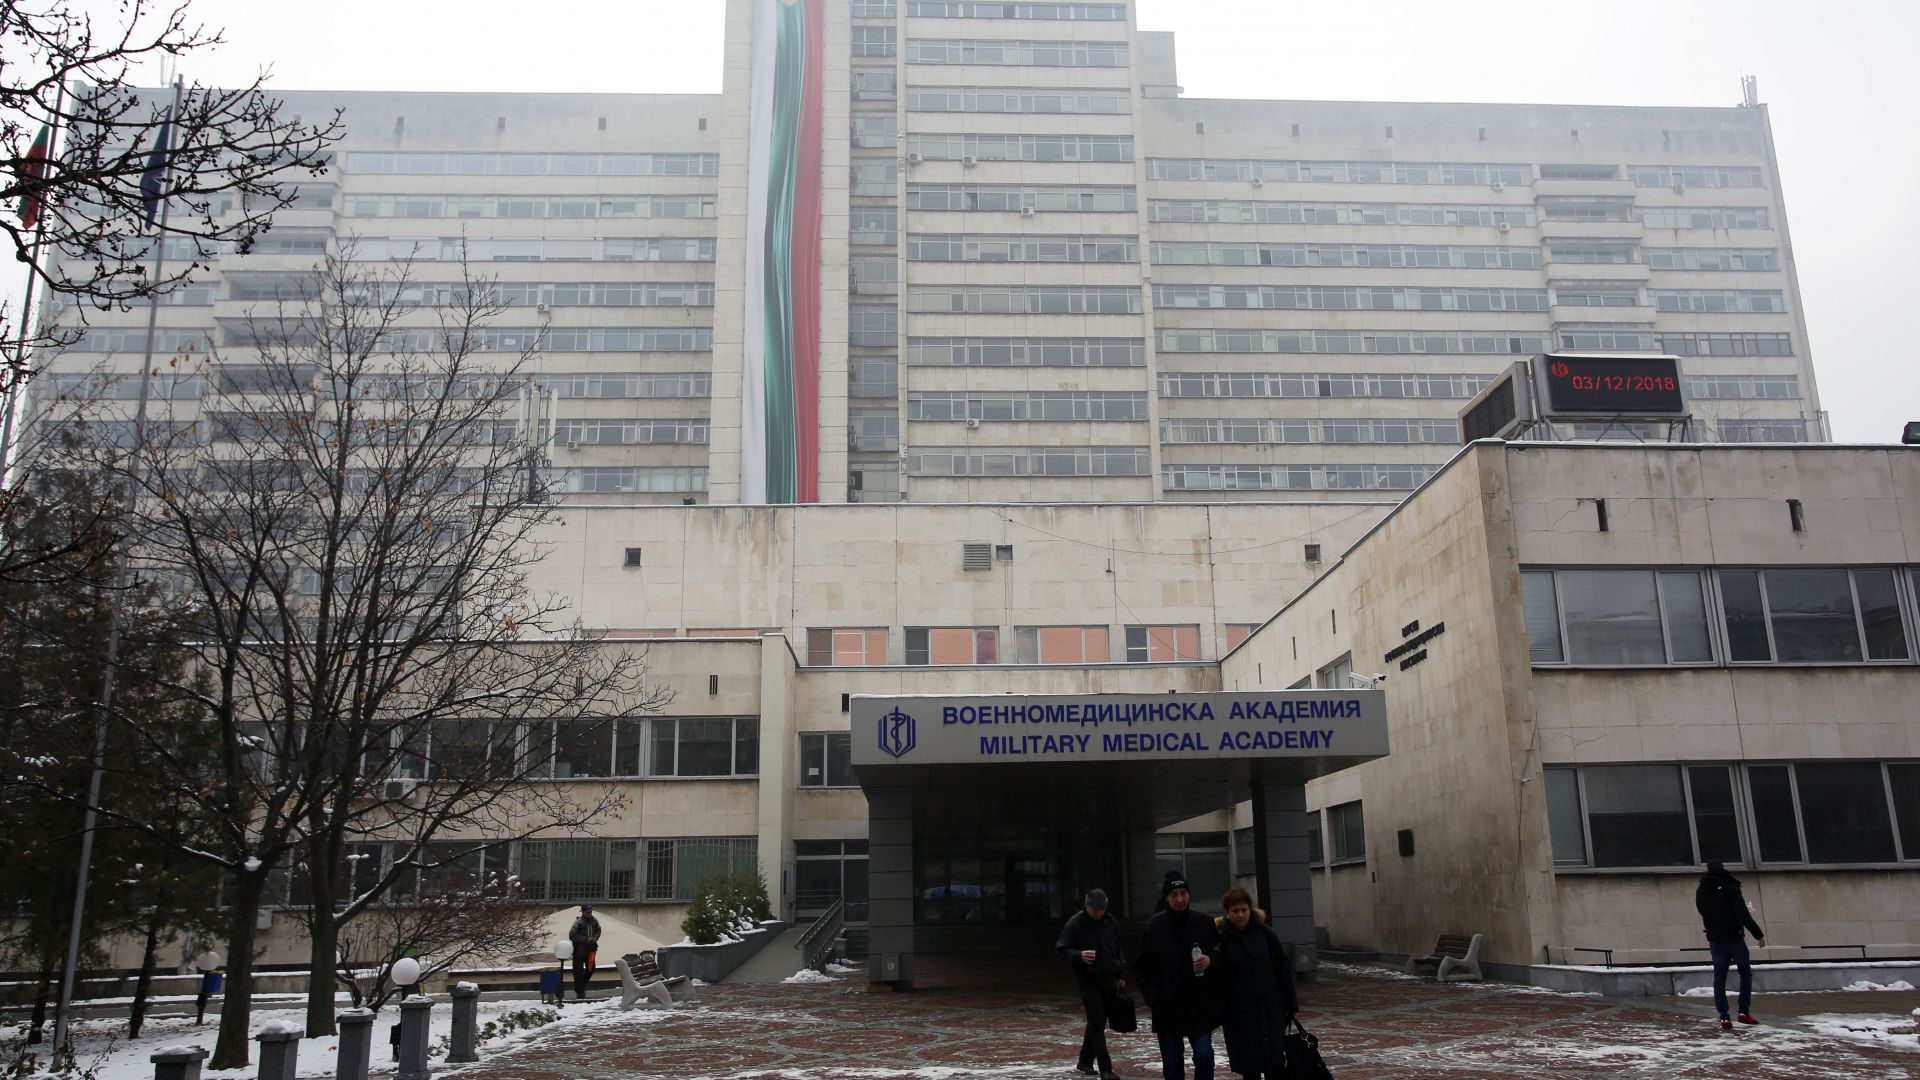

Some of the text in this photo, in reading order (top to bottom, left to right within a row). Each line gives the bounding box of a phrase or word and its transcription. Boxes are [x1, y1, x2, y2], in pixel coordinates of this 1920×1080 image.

[1572, 375, 1675, 391] 03/12/2018
[943, 700, 1361, 727] ВОЕННОМЕДИЦИНСКА АКАДЕМИЯ
[980, 729, 1335, 755] MILITARY MEDICAL ACADEMY
